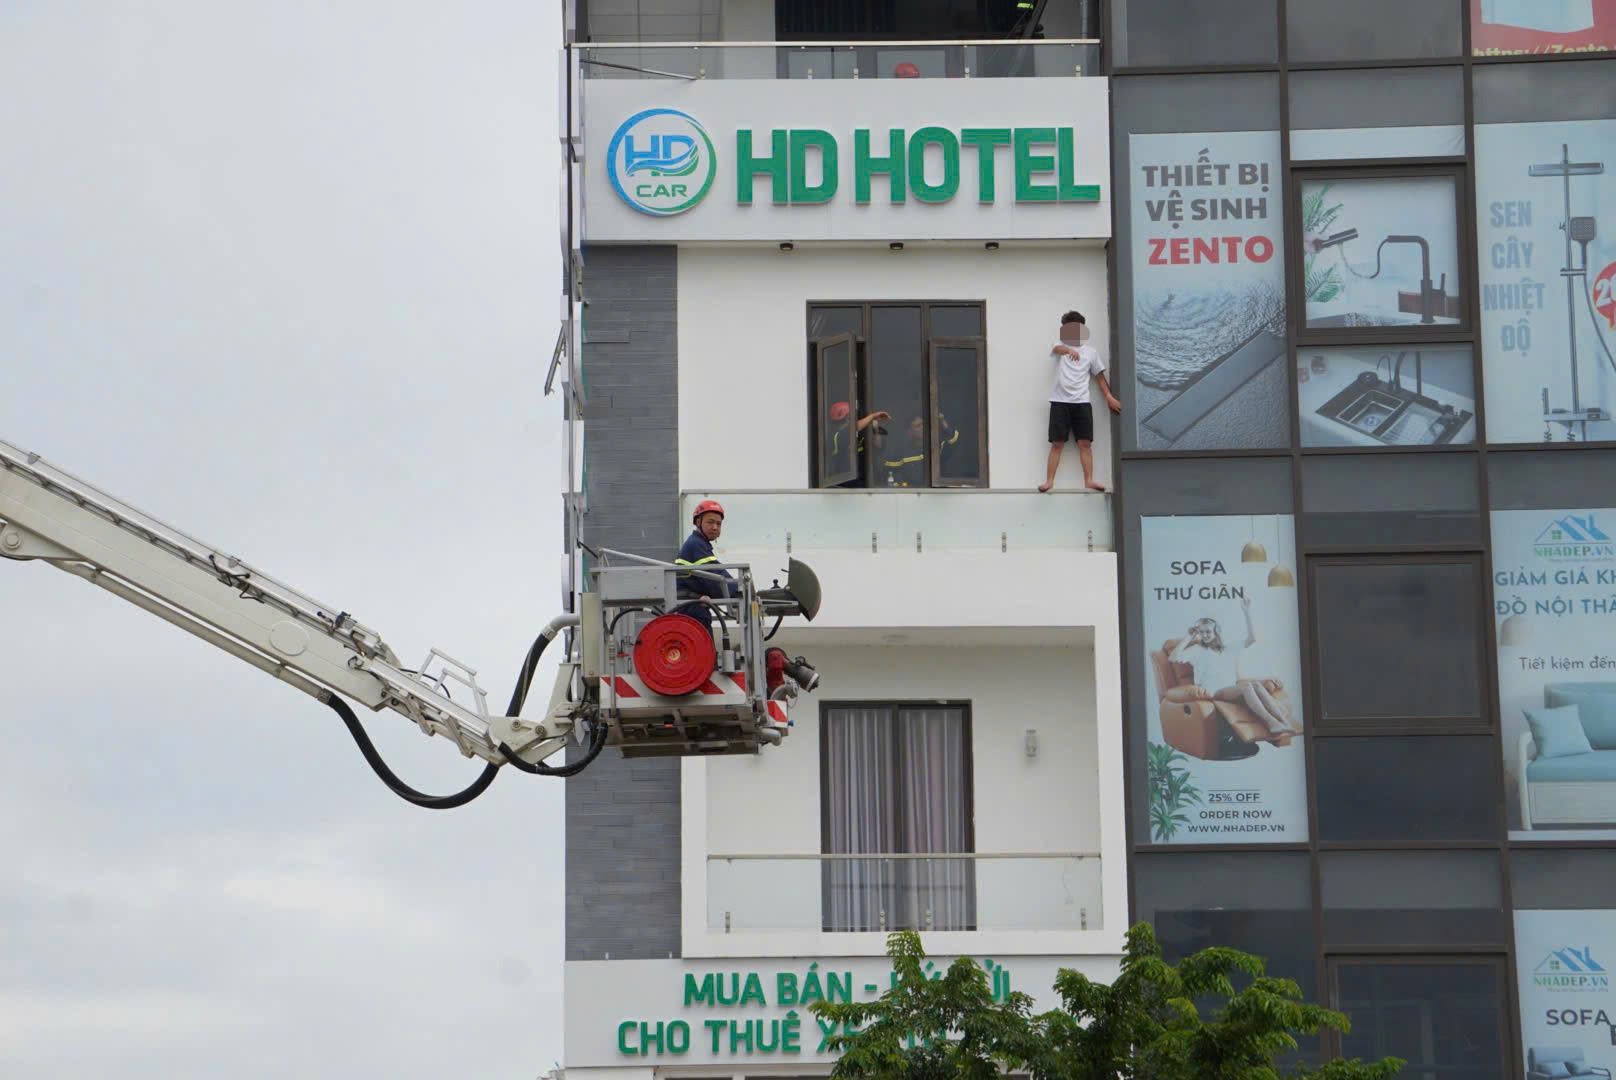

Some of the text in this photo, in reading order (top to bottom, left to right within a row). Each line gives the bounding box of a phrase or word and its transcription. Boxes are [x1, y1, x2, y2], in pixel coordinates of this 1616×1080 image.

[625, 135, 699, 177] HD
[736, 126, 1100, 205] HD HOTEL
[1142, 147, 1269, 192] THIẾT BỊ
[636, 184, 688, 198] CAR
[1145, 190, 1267, 229] VỆ SINH
[1490, 200, 1532, 228] SEN
[1148, 235, 1274, 265] ZENTO
[1491, 235, 1533, 269] CÂY
[1483, 277, 1545, 315] NHIỆT
[1500, 318, 1530, 358] ĐỘ
[1535, 545, 1615, 558] NHADEP.VN
[1170, 560, 1226, 576] SOFA
[1495, 566, 1547, 586] GIẢM
[1554, 566, 1589, 585] GIÁ
[1153, 584, 1244, 601] THƯ GIÃN
[1496, 595, 1527, 615] ĐỒ
[1535, 596, 1573, 617] NỘI
[1519, 656, 1546, 671] Tiết
[1551, 656, 1584, 671] kiệm
[1208, 793, 1261, 803] 25% OFF
[1199, 810, 1273, 820] ORDER NOW
[1187, 824, 1286, 833] WWW.NHADEP.VN
[684, 972, 767, 1008] MUA
[777, 961, 853, 1007] BÁN
[1533, 975, 1609, 986] NHADEP.VN
[1546, 1008, 1610, 1026] SOFA
[618, 1020, 691, 1056] CHO
[704, 1009, 801, 1055] THUÊ
